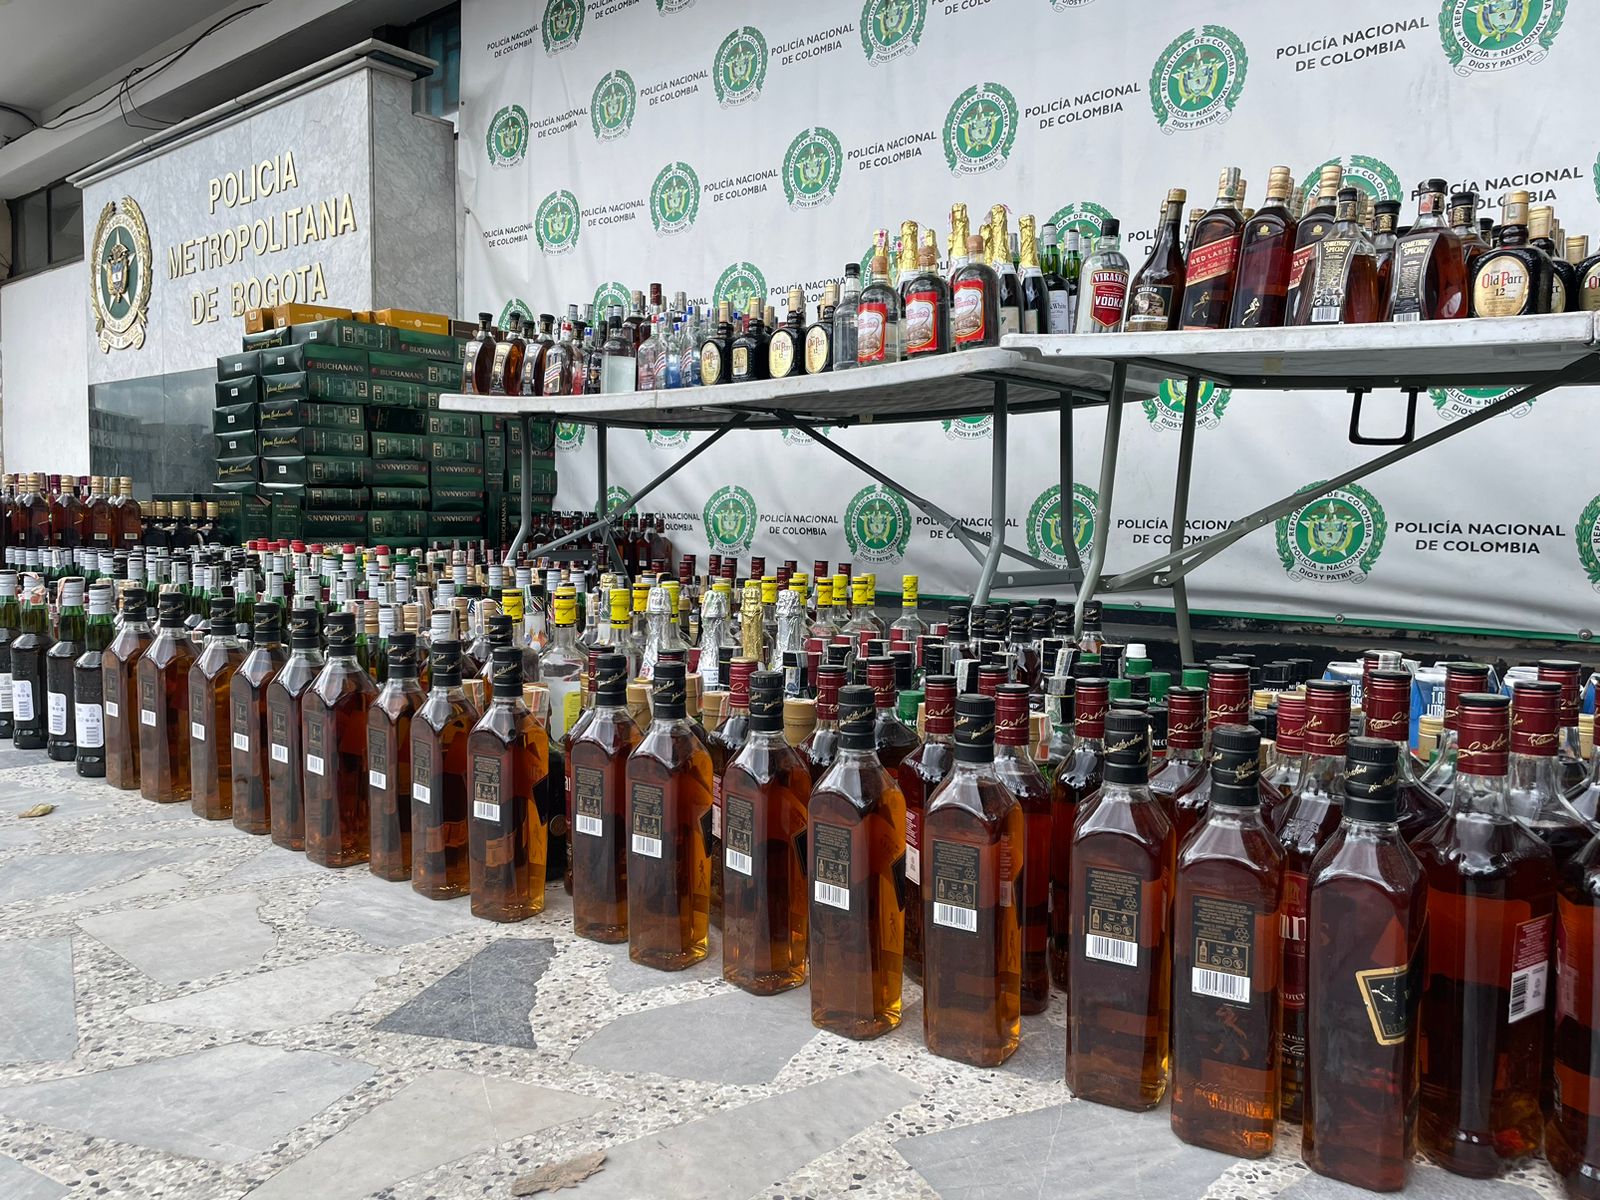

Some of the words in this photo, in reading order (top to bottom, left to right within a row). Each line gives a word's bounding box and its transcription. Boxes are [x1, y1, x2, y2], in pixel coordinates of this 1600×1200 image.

[595, 11, 604, 20] DE
[944, 5, 959, 16] DE
[510, 23, 539, 43] NACIONAL
[771, 37, 805, 56] POLICÍA
[806, 23, 855, 46] NACIONAL
[1276, 35, 1338, 60] POLICÍA
[1342, 16, 1430, 46] NACIONAL
[1458, 37, 1490, 58] POLICIA
[1500, 19, 1547, 57] NACIONAL
[494, 49, 503, 58] DE
[502, 38, 533, 55] COLOMBIA
[781, 54, 794, 66] DE
[795, 40, 843, 61] COLOMBIA
[1295, 58, 1316, 73] DE
[1319, 39, 1406, 68] COLOMBIA
[1162, 46, 1187, 92] REPUBLICA
[1194, 37, 1205, 45] DE
[1212, 38, 1235, 77] COLOMBIA
[1468, 59, 1491, 70] DIOS
[1500, 49, 1534, 67] PATRIA
[669, 69, 708, 88] NACIONAL
[649, 95, 659, 106] DE
[659, 84, 699, 103] COLOMBIA
[1025, 97, 1072, 119] POLICÍA
[1074, 82, 1141, 109] NACIONAL
[1164, 100, 1188, 118] POLICIA
[1196, 85, 1231, 117] NACIONAL
[556, 107, 589, 122] NACIONAL
[1039, 115, 1054, 130] DE
[1057, 102, 1124, 125] COLOMBIA
[1195, 110, 1221, 127] PATRIA
[537, 129, 547, 138] DE
[547, 120, 578, 136] COLOMBIA
[847, 142, 885, 161] POLICÍA
[886, 131, 937, 152] NACIONAL
[859, 158, 871, 171] DE
[873, 147, 922, 168] COLOMBIA
[208, 151, 298, 214] POLICIA
[703, 177, 734, 193] POLICÍA
[735, 169, 779, 187] NACIONAL
[1485, 167, 1584, 191] NACIONAL
[713, 192, 724, 203] DE
[725, 183, 768, 200] COLOMBIA
[608, 199, 645, 213] NACIONAL
[587, 218, 597, 227] DE
[597, 210, 636, 226] COLOMBIA
[167, 192, 357, 279] METROPOLITANA
[488, 240, 496, 248] DE
[496, 234, 529, 246] COLOMBIA
[1482, 272, 1500, 288] Old
[1500, 271, 1522, 288] Parr
[191, 286, 219, 325] DE
[230, 262, 328, 317] BOGOTA
[1494, 287, 1505, 297] 12
[667, 513, 701, 522] NACIONAL
[760, 512, 791, 524] POLICÍA
[792, 514, 839, 524] NACIONAL
[1117, 517, 1169, 530] POLICÍA
[1326, 490, 1339, 499] DE
[1347, 494, 1372, 539] COLOMBIA
[665, 523, 694, 532] OLOMBIA
[769, 526, 780, 535] DE
[782, 527, 828, 536] COLOMBIA
[930, 530, 943, 539] DE
[1394, 520, 1462, 535] POLICÍA
[1467, 524, 1566, 537] NACIONAL
[1133, 535, 1150, 545] DE
[1415, 539, 1438, 551] DE
[1443, 540, 1541, 555] COLOMBIA
[1291, 545, 1317, 571] POLICIA
[1325, 546, 1368, 571] NACIONAL
[1325, 568, 1356, 581] PATRIA
